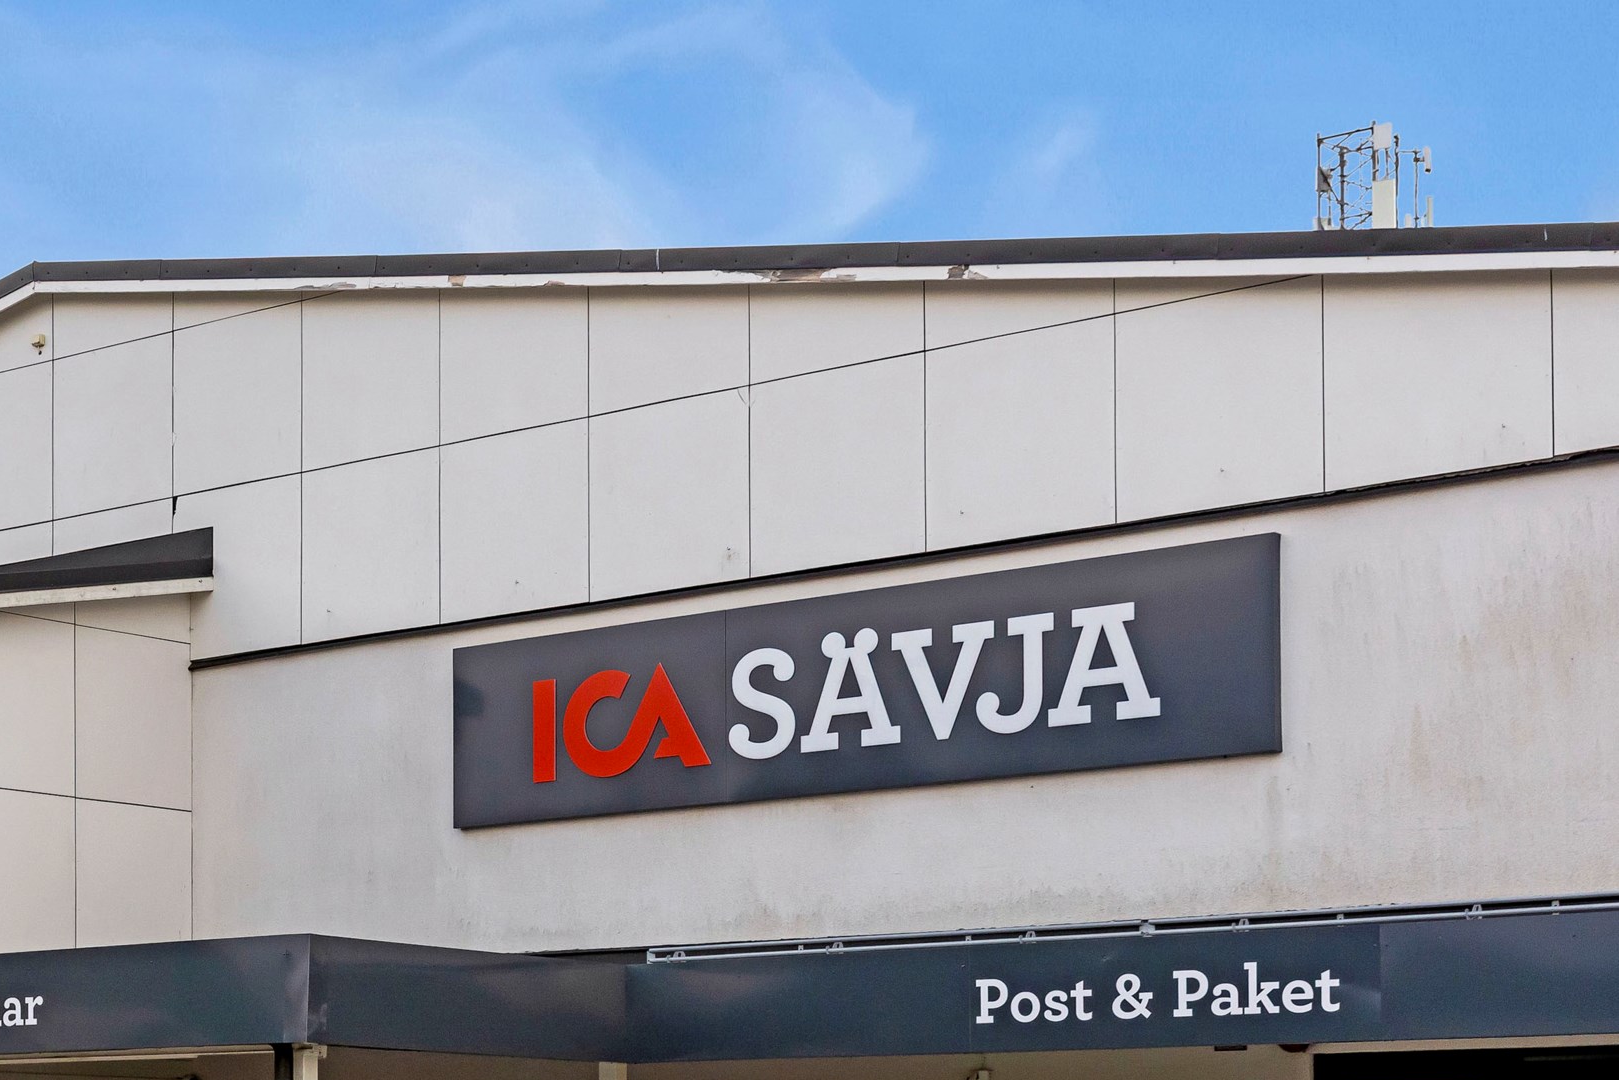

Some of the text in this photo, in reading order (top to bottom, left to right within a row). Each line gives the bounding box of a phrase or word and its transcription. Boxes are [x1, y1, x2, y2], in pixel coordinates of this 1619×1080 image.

[532, 602, 1161, 783] ICA SÄVJA
[975, 962, 1341, 1024] Post & Paket
